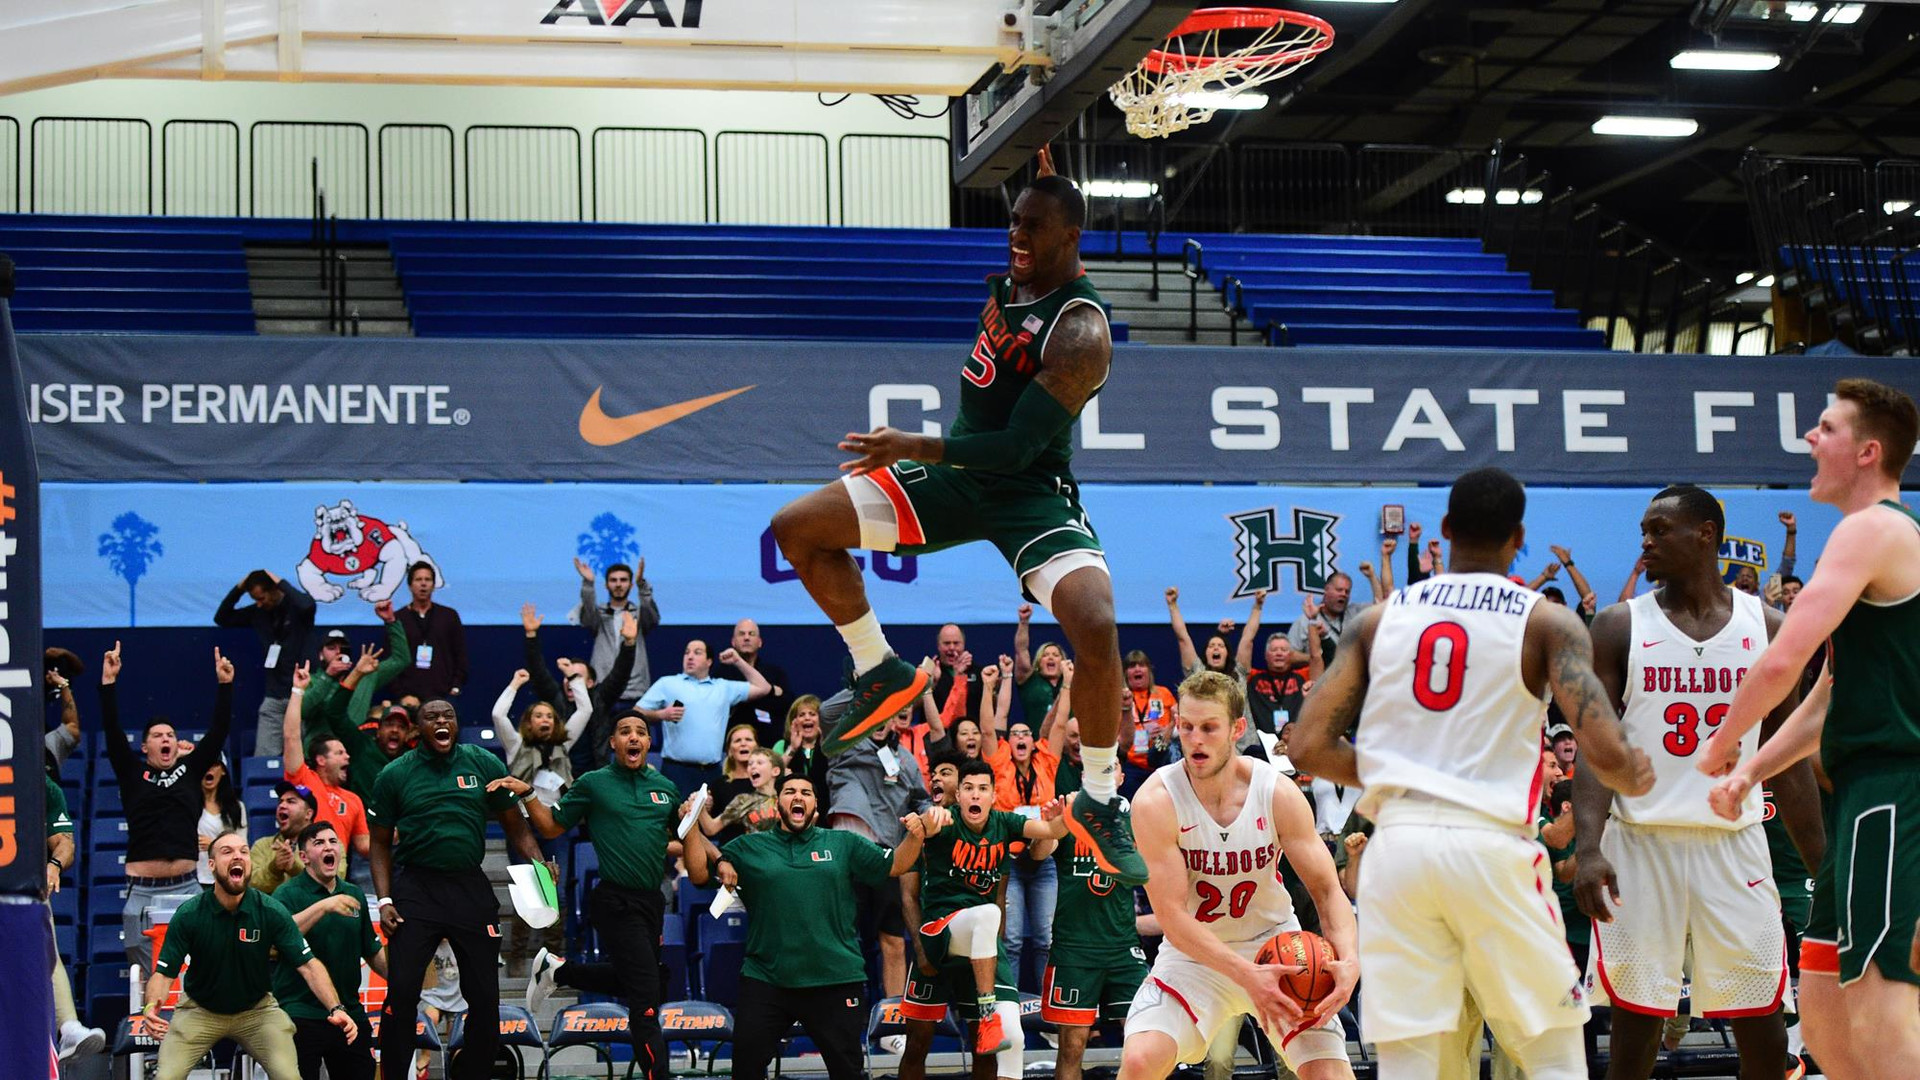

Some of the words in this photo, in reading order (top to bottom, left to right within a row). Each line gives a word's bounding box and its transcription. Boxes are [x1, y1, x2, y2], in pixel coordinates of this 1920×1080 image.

[962, 330, 996, 388] 5
[28, 383, 126, 423] ISER
[869, 384, 1145, 449] CL
[1210, 386, 1628, 452] STATE
[1419, 583, 1528, 616] WILLIAMS
[1413, 621, 1469, 712] 0
[457, 775, 478, 789] U
[650, 792, 669, 804] U
[811, 850, 832, 862] U
[1195, 880, 1257, 923] 20
[239, 928, 261, 943] U
[908, 980, 934, 1000] U
[1053, 986, 1080, 1005] U
[846, 997, 859, 1007] U
[563, 1010, 630, 1032] TITANS
[661, 1009, 726, 1030] TITANS
